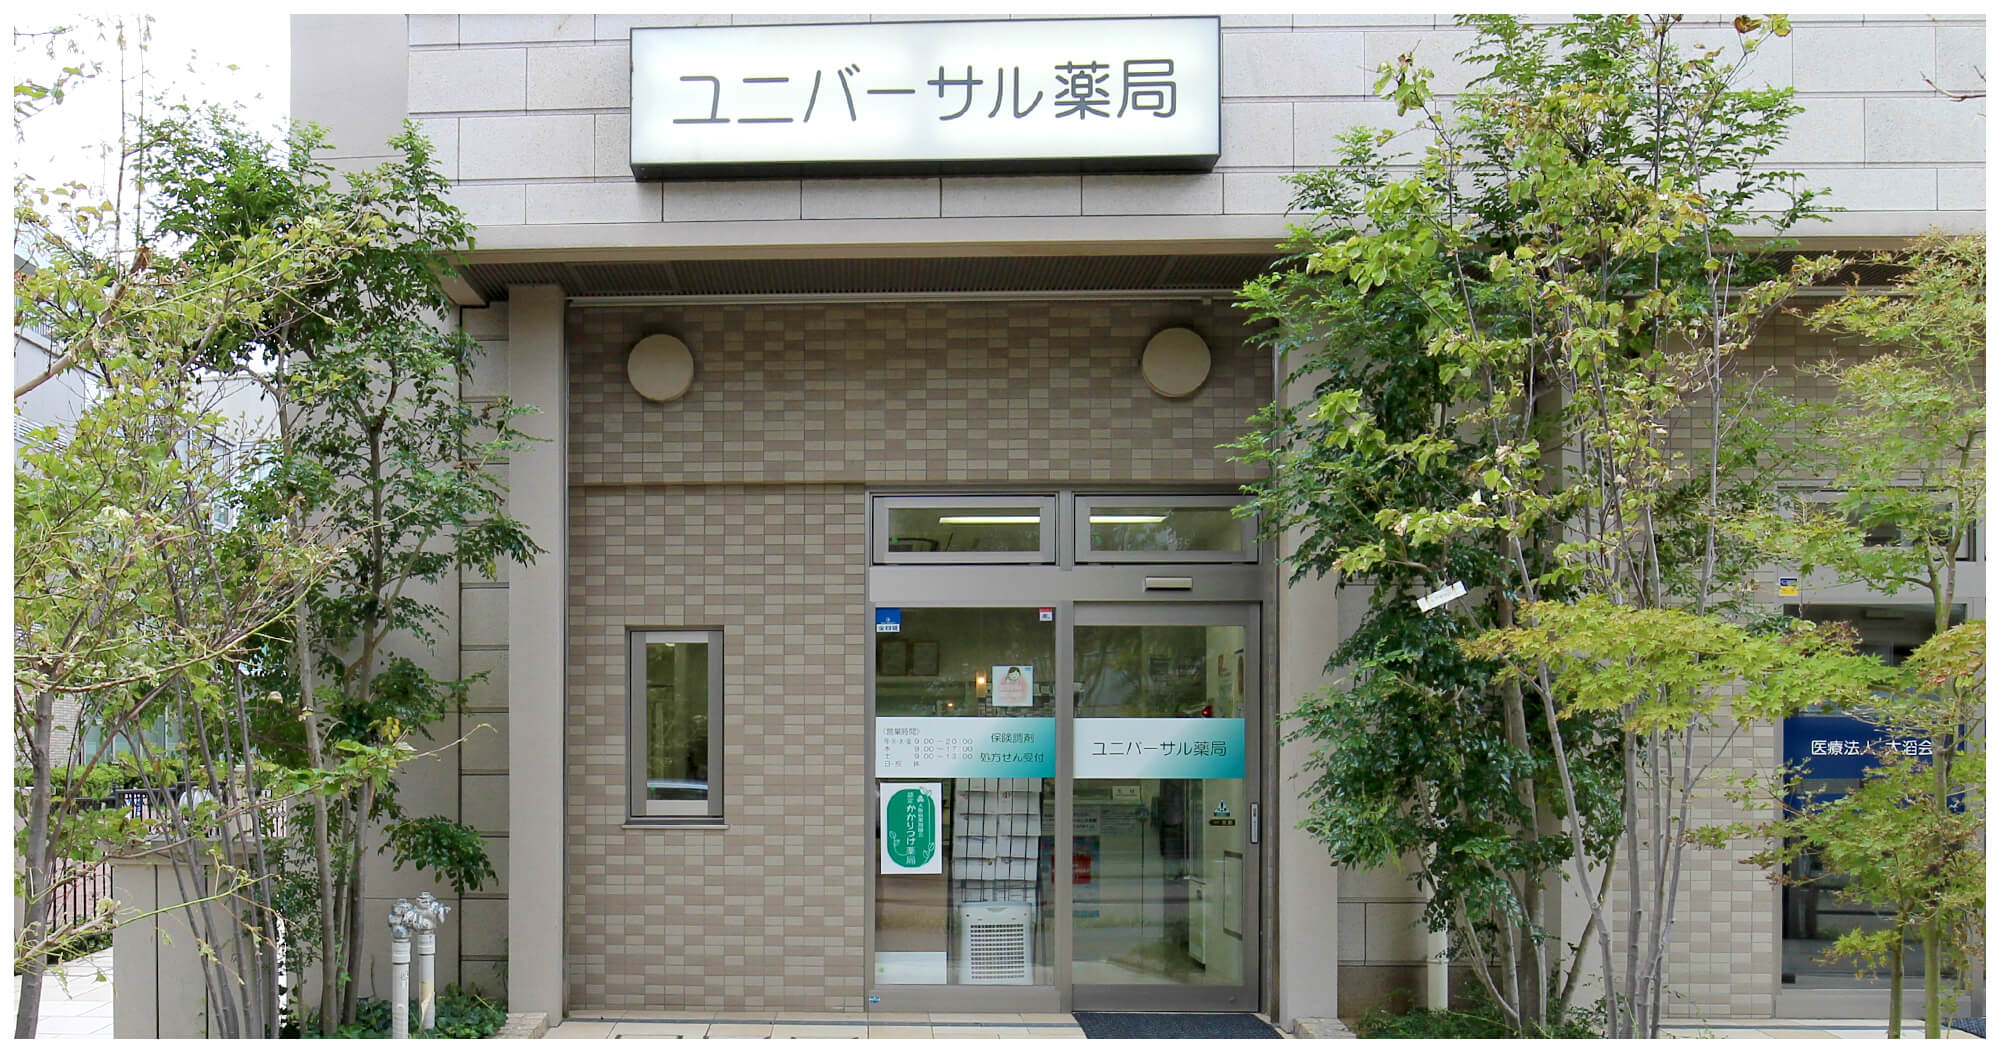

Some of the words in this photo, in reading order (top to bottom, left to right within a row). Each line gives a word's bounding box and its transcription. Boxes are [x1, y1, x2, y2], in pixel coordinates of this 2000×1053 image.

[672, 58, 1177, 124] ユニバーサル薬局
[991, 732, 1035, 744] 保険調剤
[1091, 740, 1228, 757] ユニバーサル薬局
[980, 752, 1045, 763] 処方せん受付
